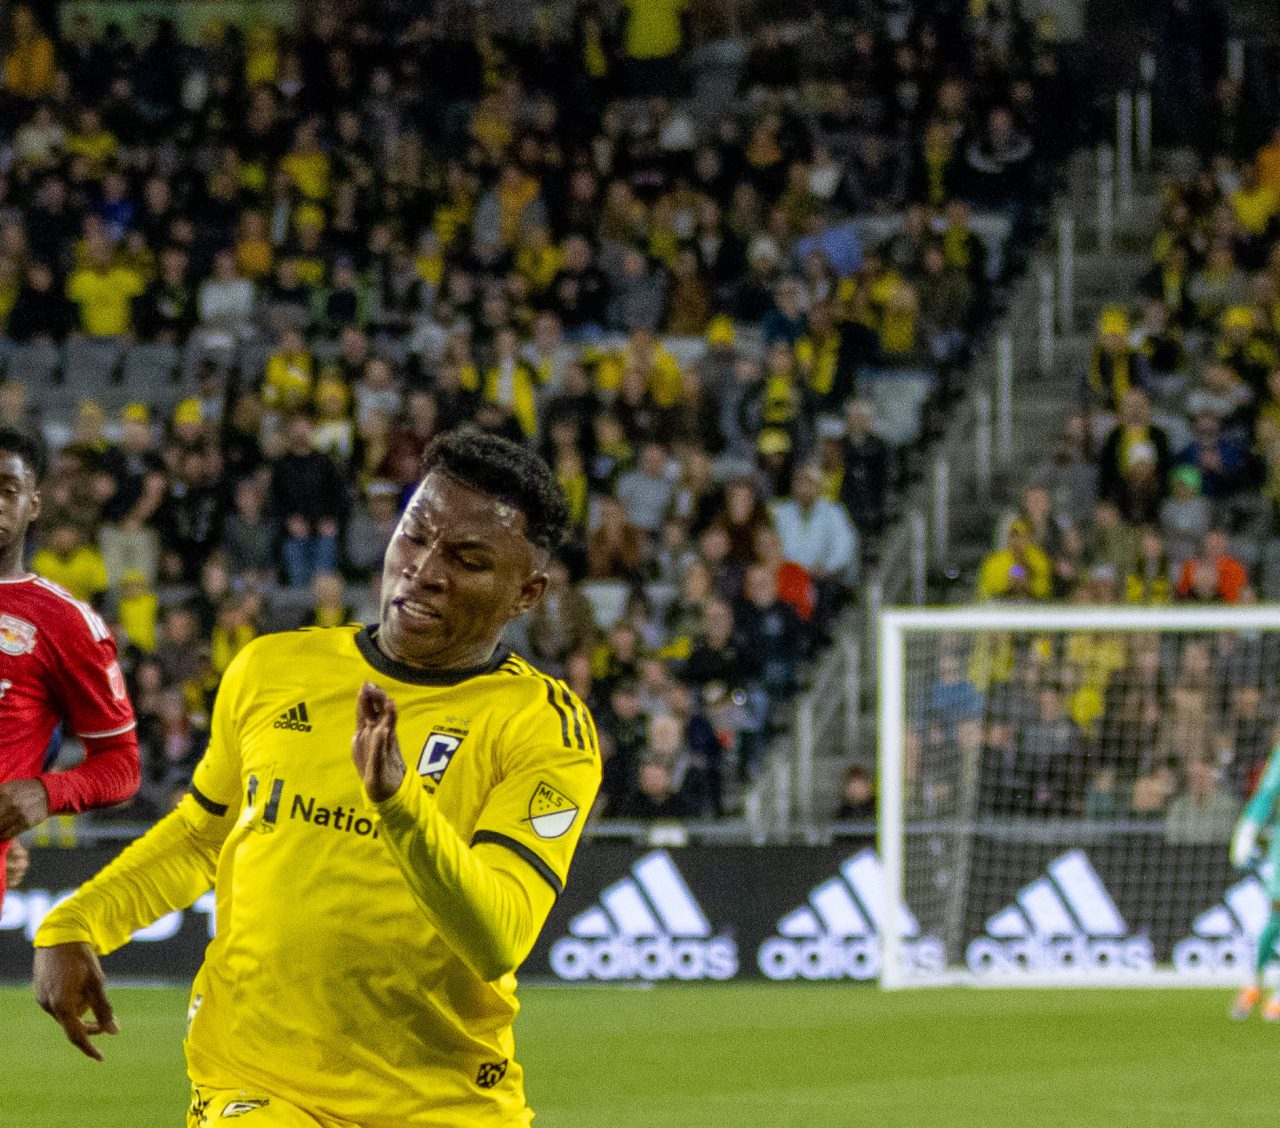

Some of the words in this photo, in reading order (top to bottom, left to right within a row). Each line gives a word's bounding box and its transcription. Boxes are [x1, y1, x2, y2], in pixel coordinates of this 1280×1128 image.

[273, 719, 313, 733] adidas
[539, 787, 564, 808] MLS
[549, 935, 740, 981] adidas
[756, 935, 946, 981] adids
